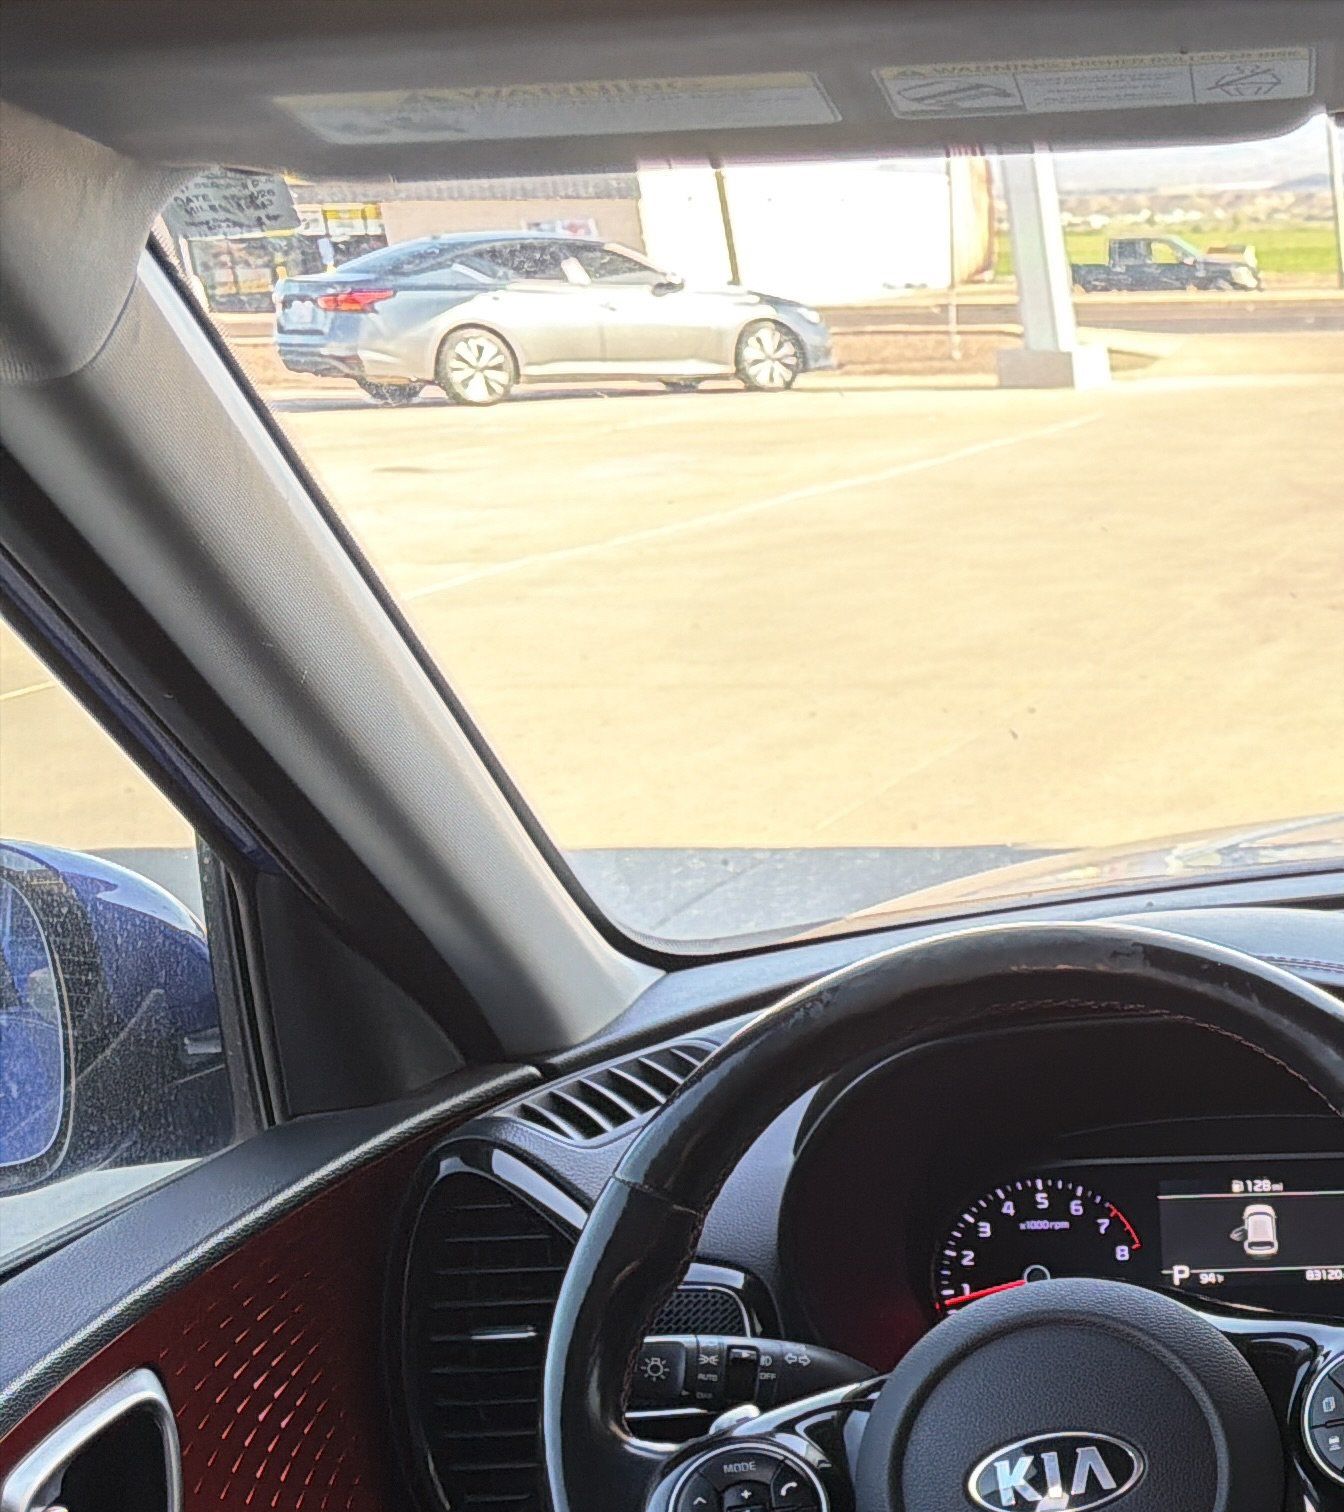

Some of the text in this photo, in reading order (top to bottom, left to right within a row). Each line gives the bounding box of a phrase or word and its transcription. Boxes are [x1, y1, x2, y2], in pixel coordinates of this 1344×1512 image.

[1001, 1201, 1016, 1217] 4
[1035, 1193, 1049, 1209] 5
[1069, 1200, 1084, 1216] 6
[978, 1222, 992, 1238] 3
[1096, 1218, 1110, 1235] 7
[961, 1250, 975, 1266] 2
[1115, 1245, 1130, 1261] 8
[1172, 1265, 1191, 1287] P
[697, 1373, 718, 1382] AUTO
[759, 1372, 777, 1381] OFF
[723, 1461, 757, 1474] MODE
[993, 1446, 1118, 1506] KIA
